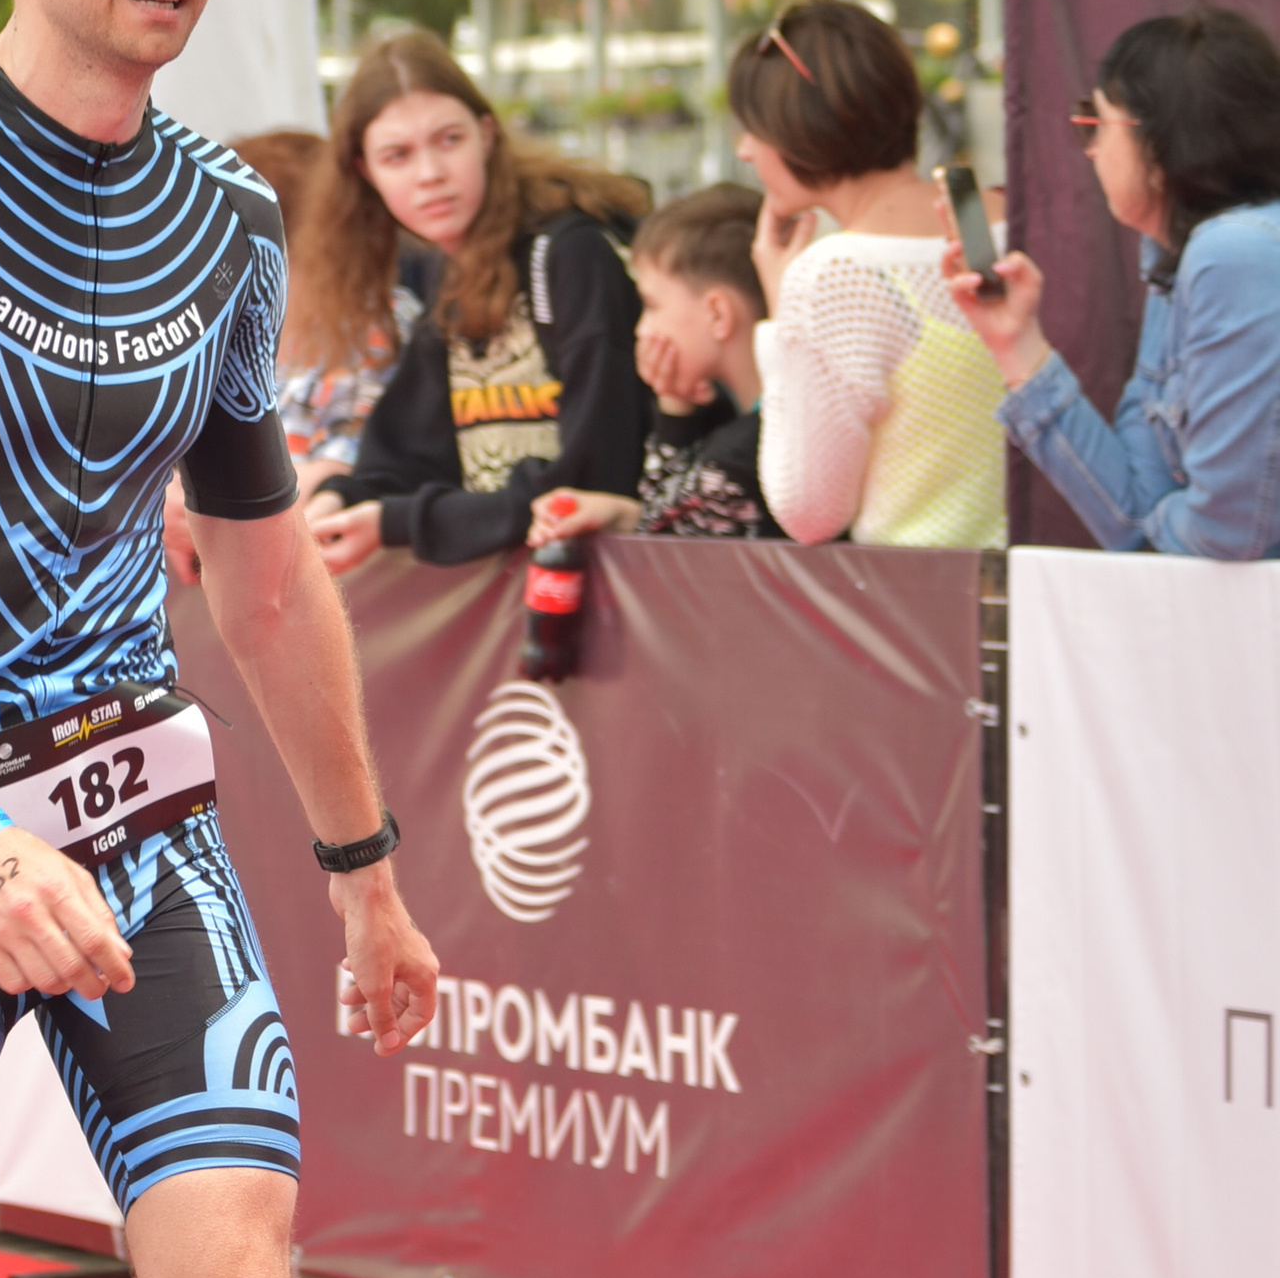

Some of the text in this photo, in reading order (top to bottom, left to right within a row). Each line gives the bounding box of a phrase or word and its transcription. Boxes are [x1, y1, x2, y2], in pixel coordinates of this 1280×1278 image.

[116, 300, 206, 365] Factory
[52, 716, 80, 743] IRON
[91, 700, 122, 724] STAR
[48, 746, 149, 832] 182
[92, 825, 127, 856] IGOR
[336, 964, 742, 1094] ГПРОМБАНК
[404, 1062, 670, 1180] ПРЕМИУМ
